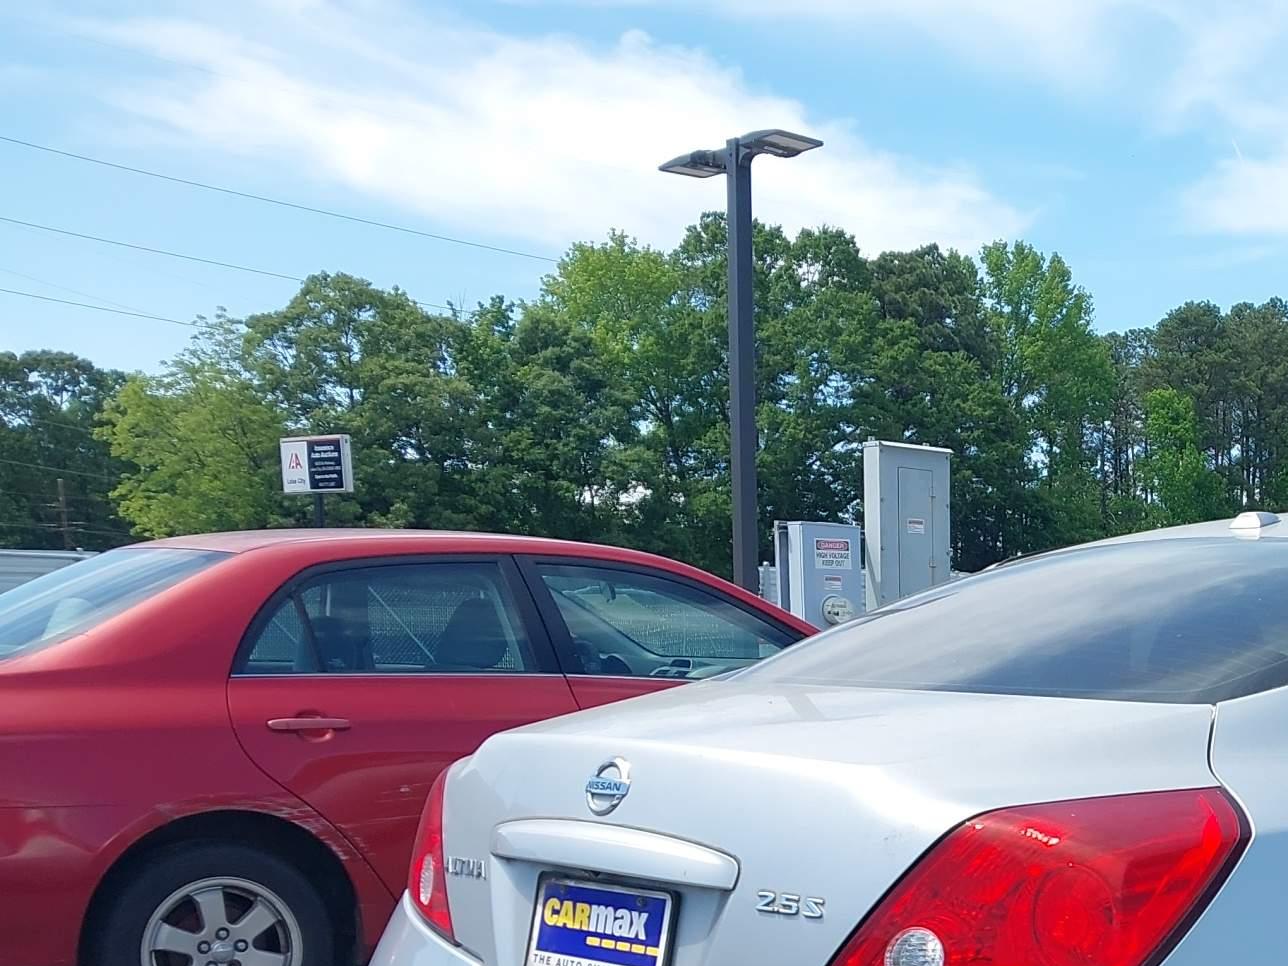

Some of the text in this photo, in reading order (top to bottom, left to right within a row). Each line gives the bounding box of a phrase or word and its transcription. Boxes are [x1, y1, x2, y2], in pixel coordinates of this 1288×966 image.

[819, 542, 846, 550] DANGER
[816, 551, 850, 560] HIGH VOLTAGE
[821, 559, 834, 567] KEEP
[586, 780, 621, 792] NISSAN
[533, 953, 552, 966] THE
